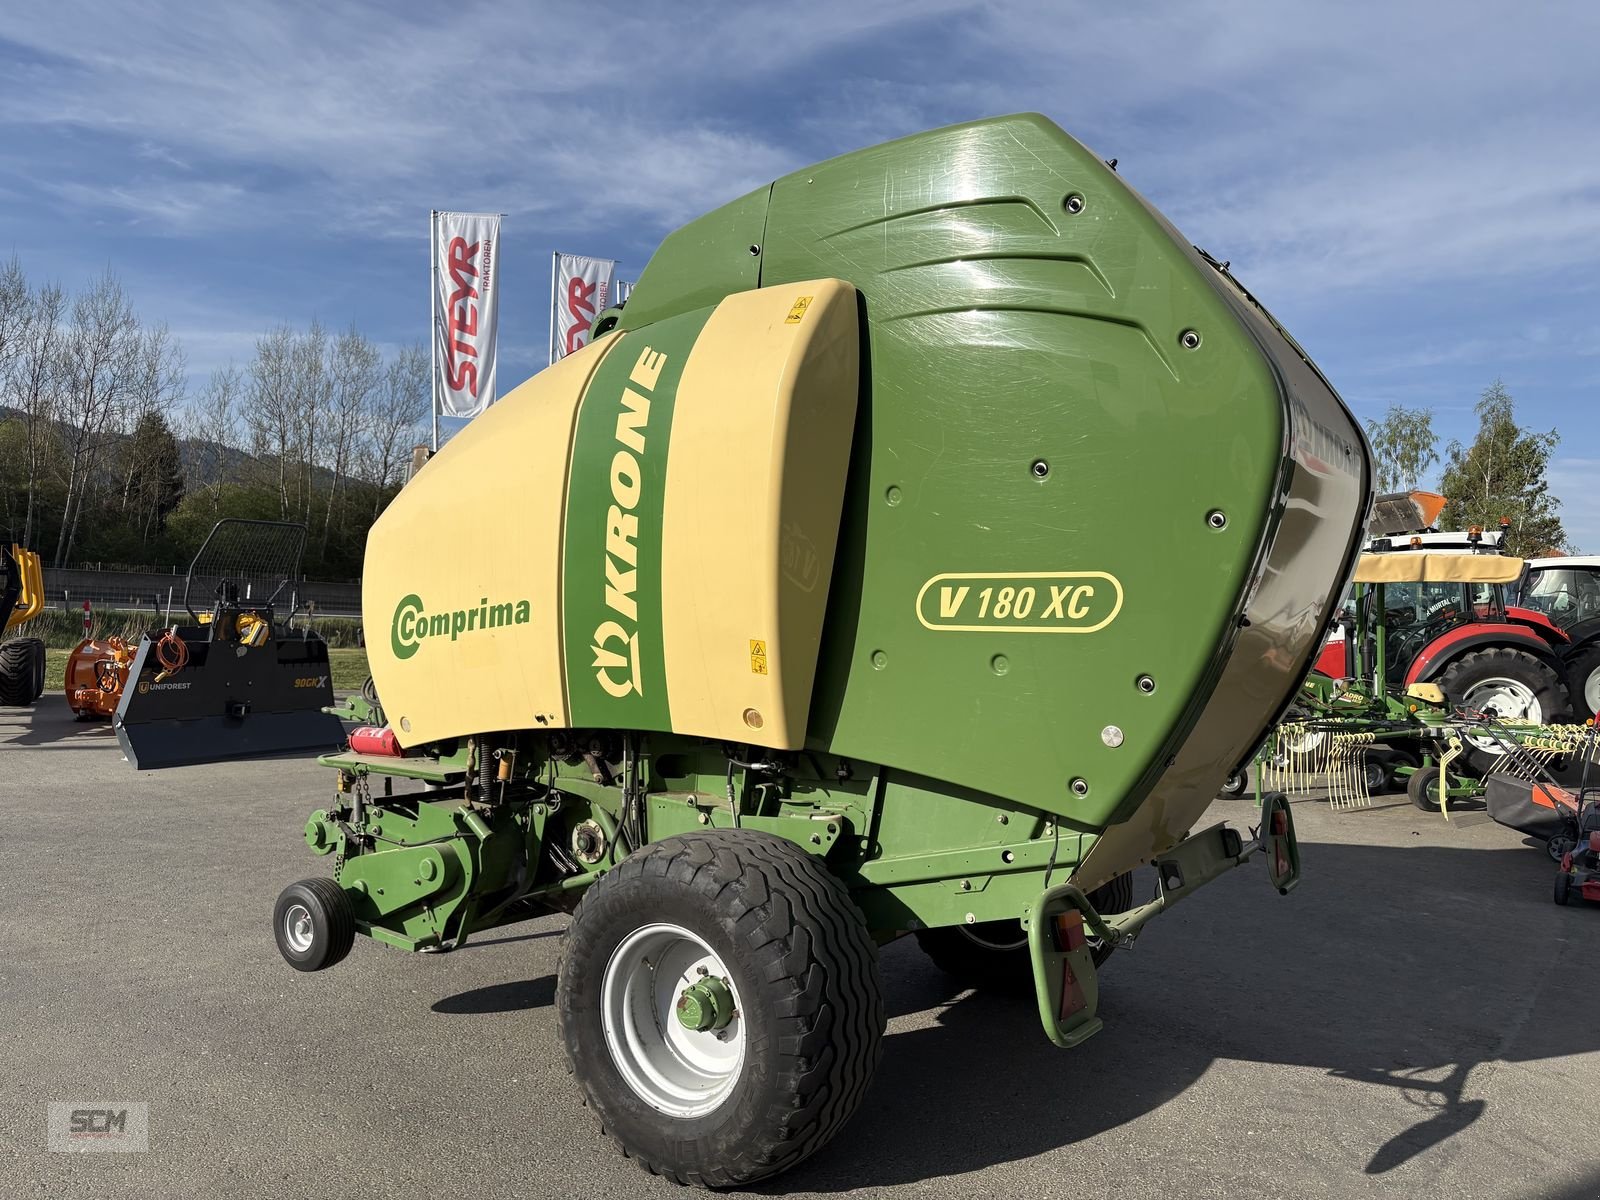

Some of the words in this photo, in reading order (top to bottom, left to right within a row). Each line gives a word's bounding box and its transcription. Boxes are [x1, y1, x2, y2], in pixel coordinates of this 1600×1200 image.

[482, 239, 492, 293] TRAKTOREN
[447, 236, 480, 398] STEYR
[605, 345, 668, 622] KRONE
[391, 593, 531, 660] Comprima
[940, 586, 970, 618] V
[978, 586, 1036, 619] 180
[1040, 585, 1095, 619] XC
[149, 682, 192, 691] UNIFOREST
[294, 676, 329, 688] 90GKX
